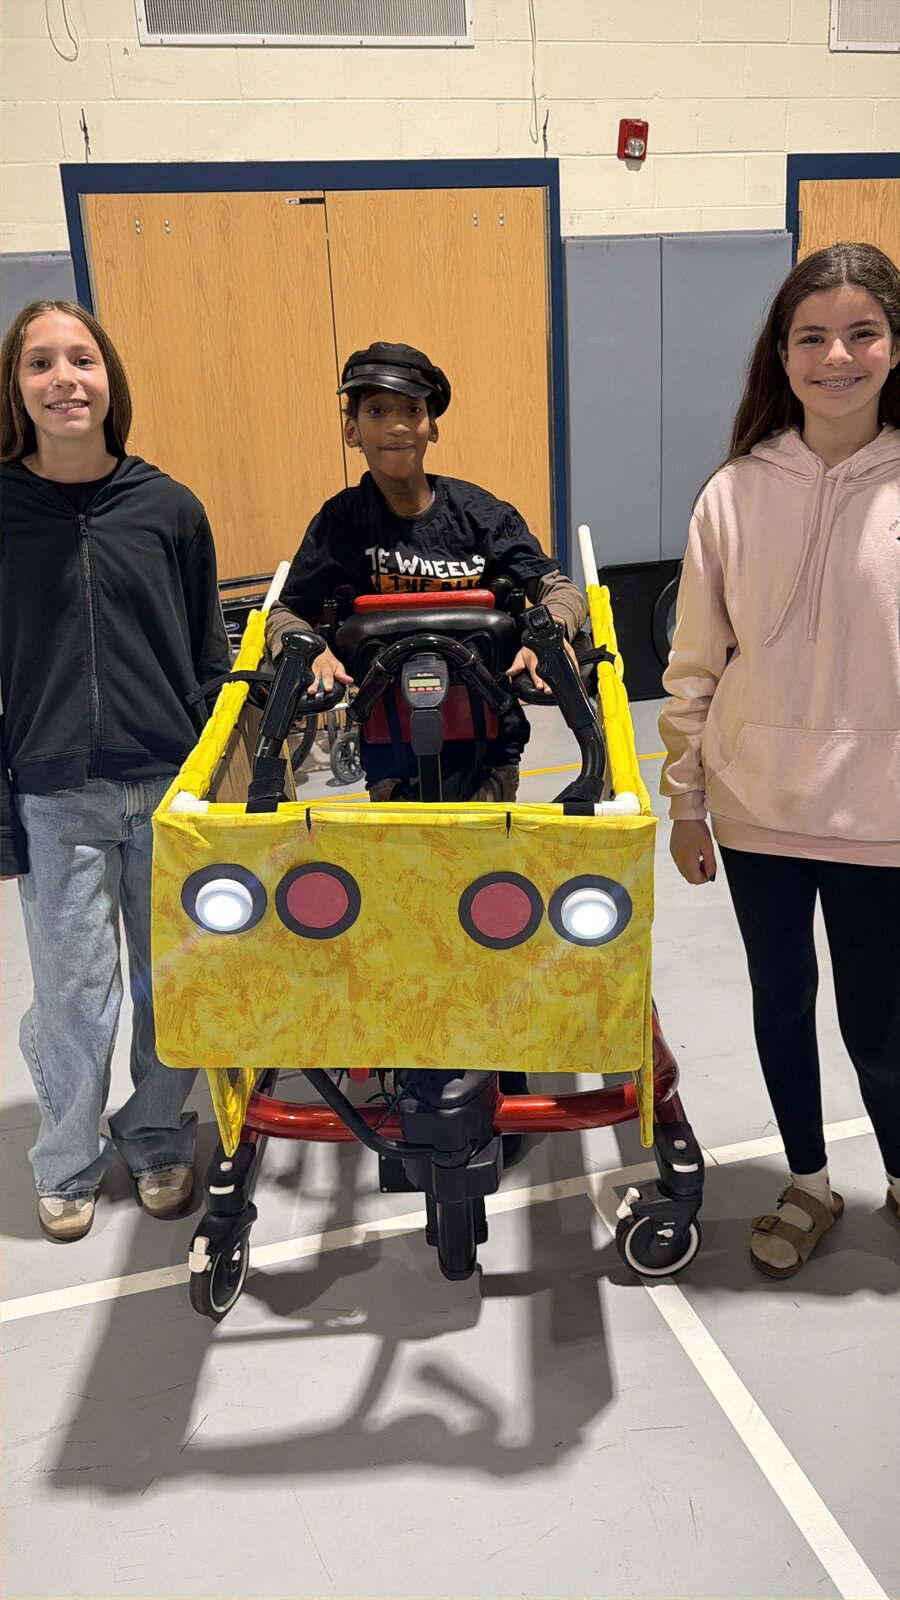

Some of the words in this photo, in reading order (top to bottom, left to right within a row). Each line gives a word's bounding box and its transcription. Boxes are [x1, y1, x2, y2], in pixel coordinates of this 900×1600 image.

[365, 546, 390, 573] TE
[395, 551, 486, 578] WHEELS
[388, 575, 434, 592] THE
